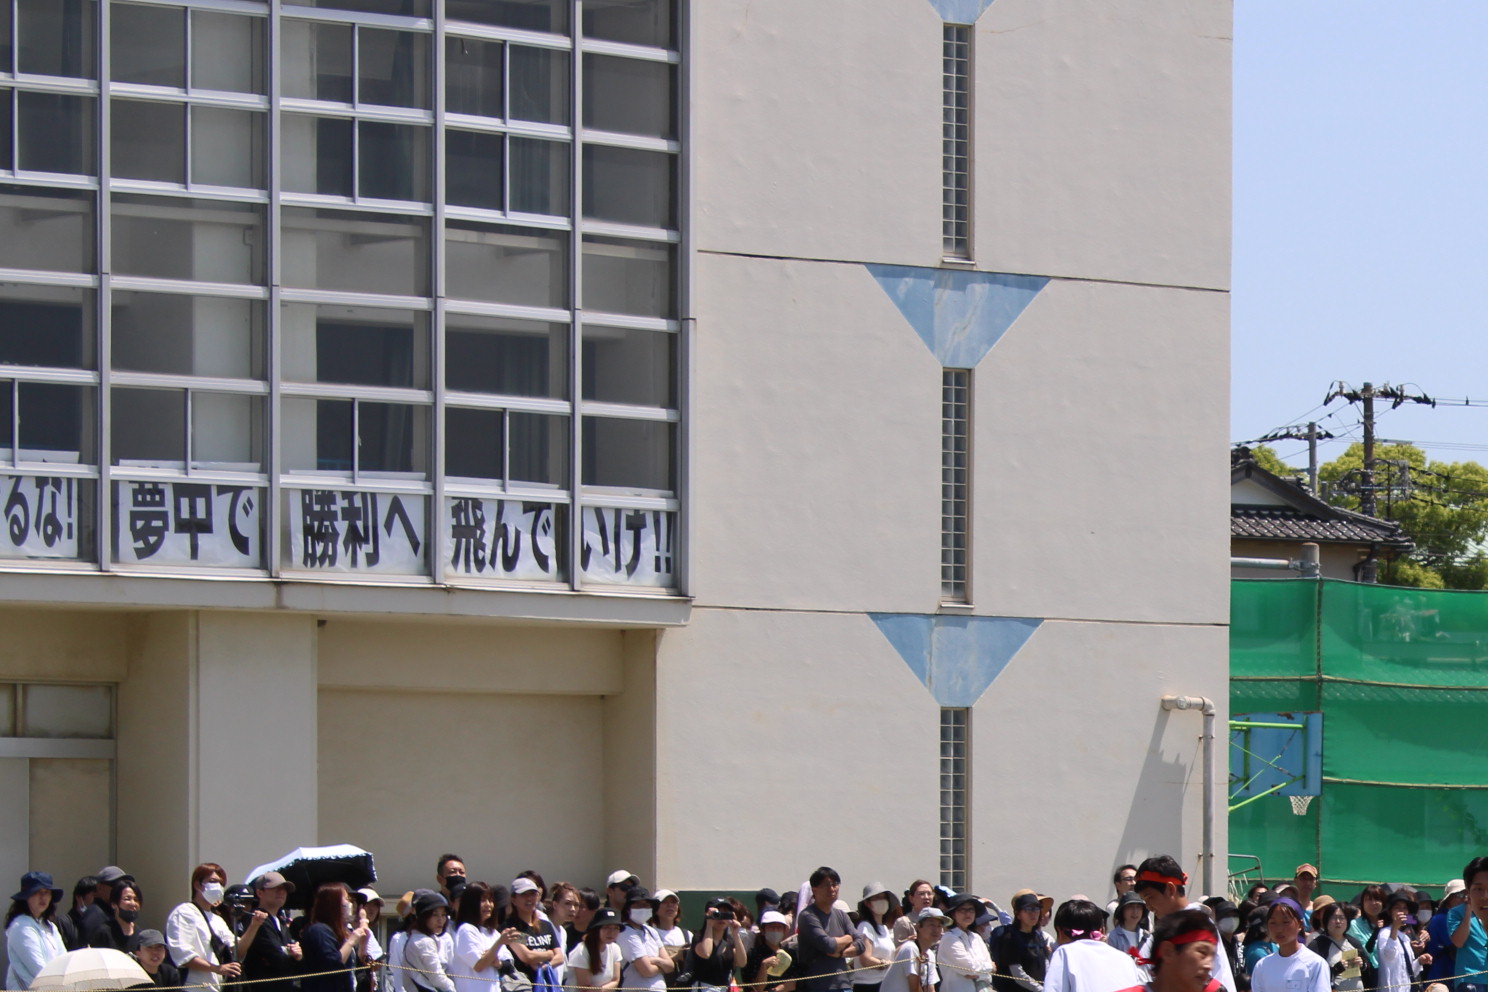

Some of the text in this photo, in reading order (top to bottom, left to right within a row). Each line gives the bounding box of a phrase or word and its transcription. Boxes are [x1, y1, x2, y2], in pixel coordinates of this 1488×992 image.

[128, 481, 254, 561] 夢中で
[301, 489, 421, 569] 勝利へ
[451, 497, 552, 574] 飛んで
